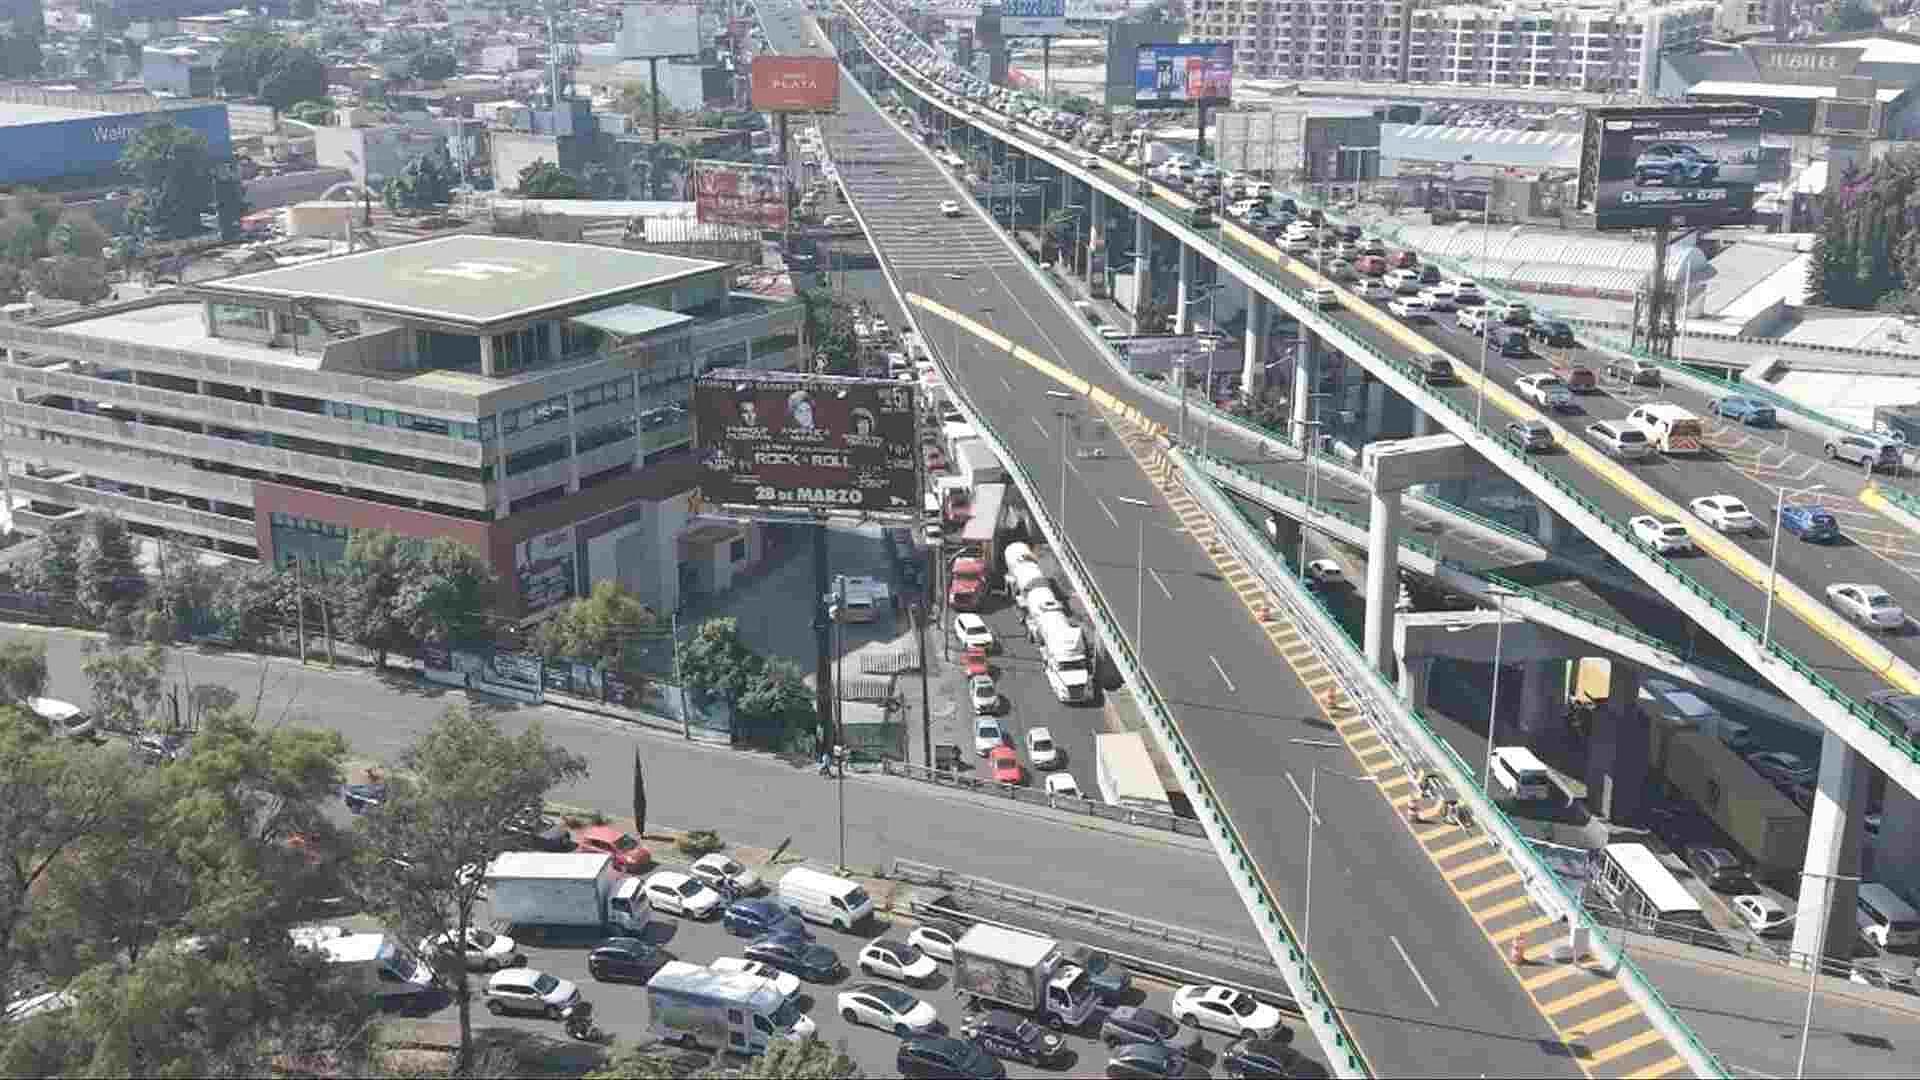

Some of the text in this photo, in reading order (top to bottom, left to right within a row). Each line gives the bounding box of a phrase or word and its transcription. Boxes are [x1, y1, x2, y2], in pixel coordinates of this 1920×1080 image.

[754, 452, 800, 466] ROCK
[755, 486, 863, 504] 28 DE MARZO
